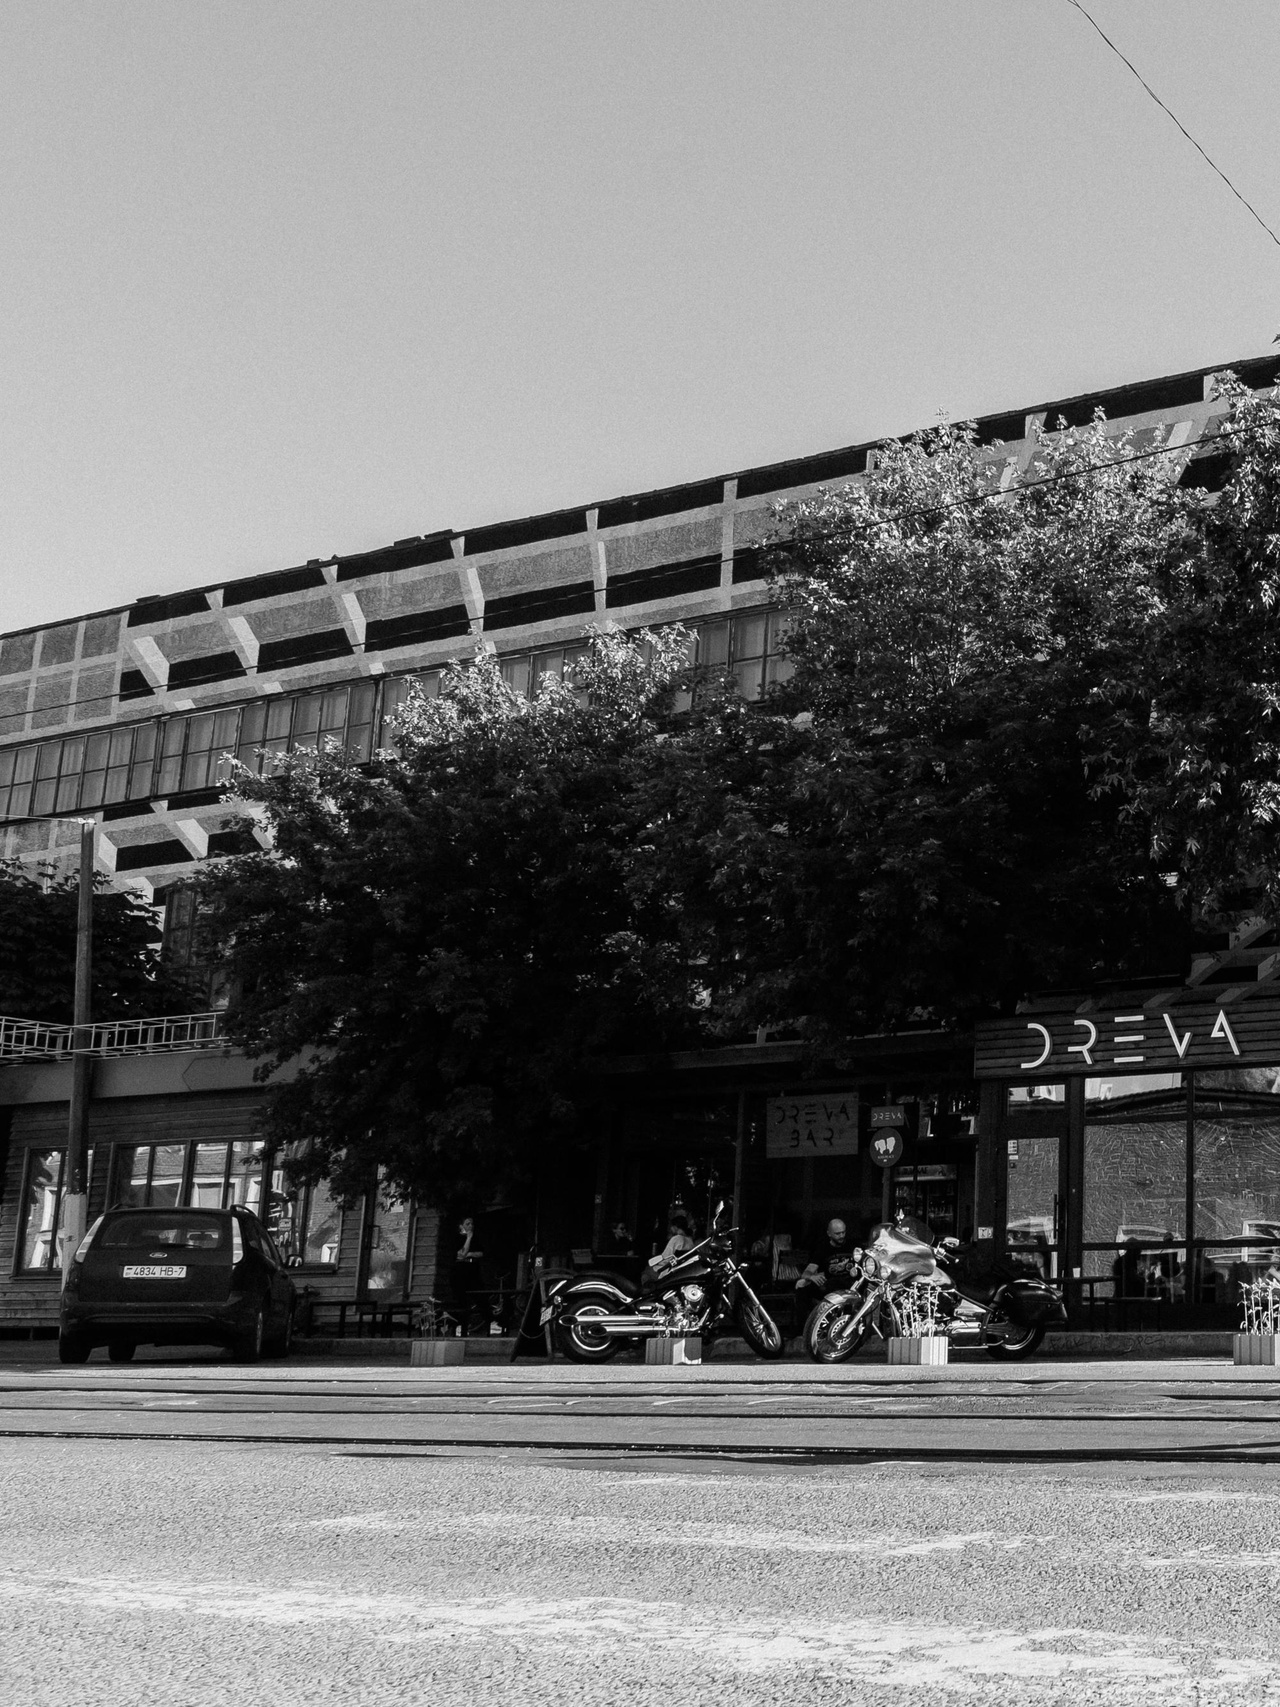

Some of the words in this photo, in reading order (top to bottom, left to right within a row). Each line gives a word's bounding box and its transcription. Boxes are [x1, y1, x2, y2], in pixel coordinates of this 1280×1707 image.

[1020, 1008, 1241, 1069] DREVA
[775, 1102, 851, 1124] DREVA
[872, 1112, 903, 1122] DREVA
[789, 1127, 835, 1149] BAR
[133, 1266, 156, 1276] 4834
[160, 1266, 185, 1276] HB-7
